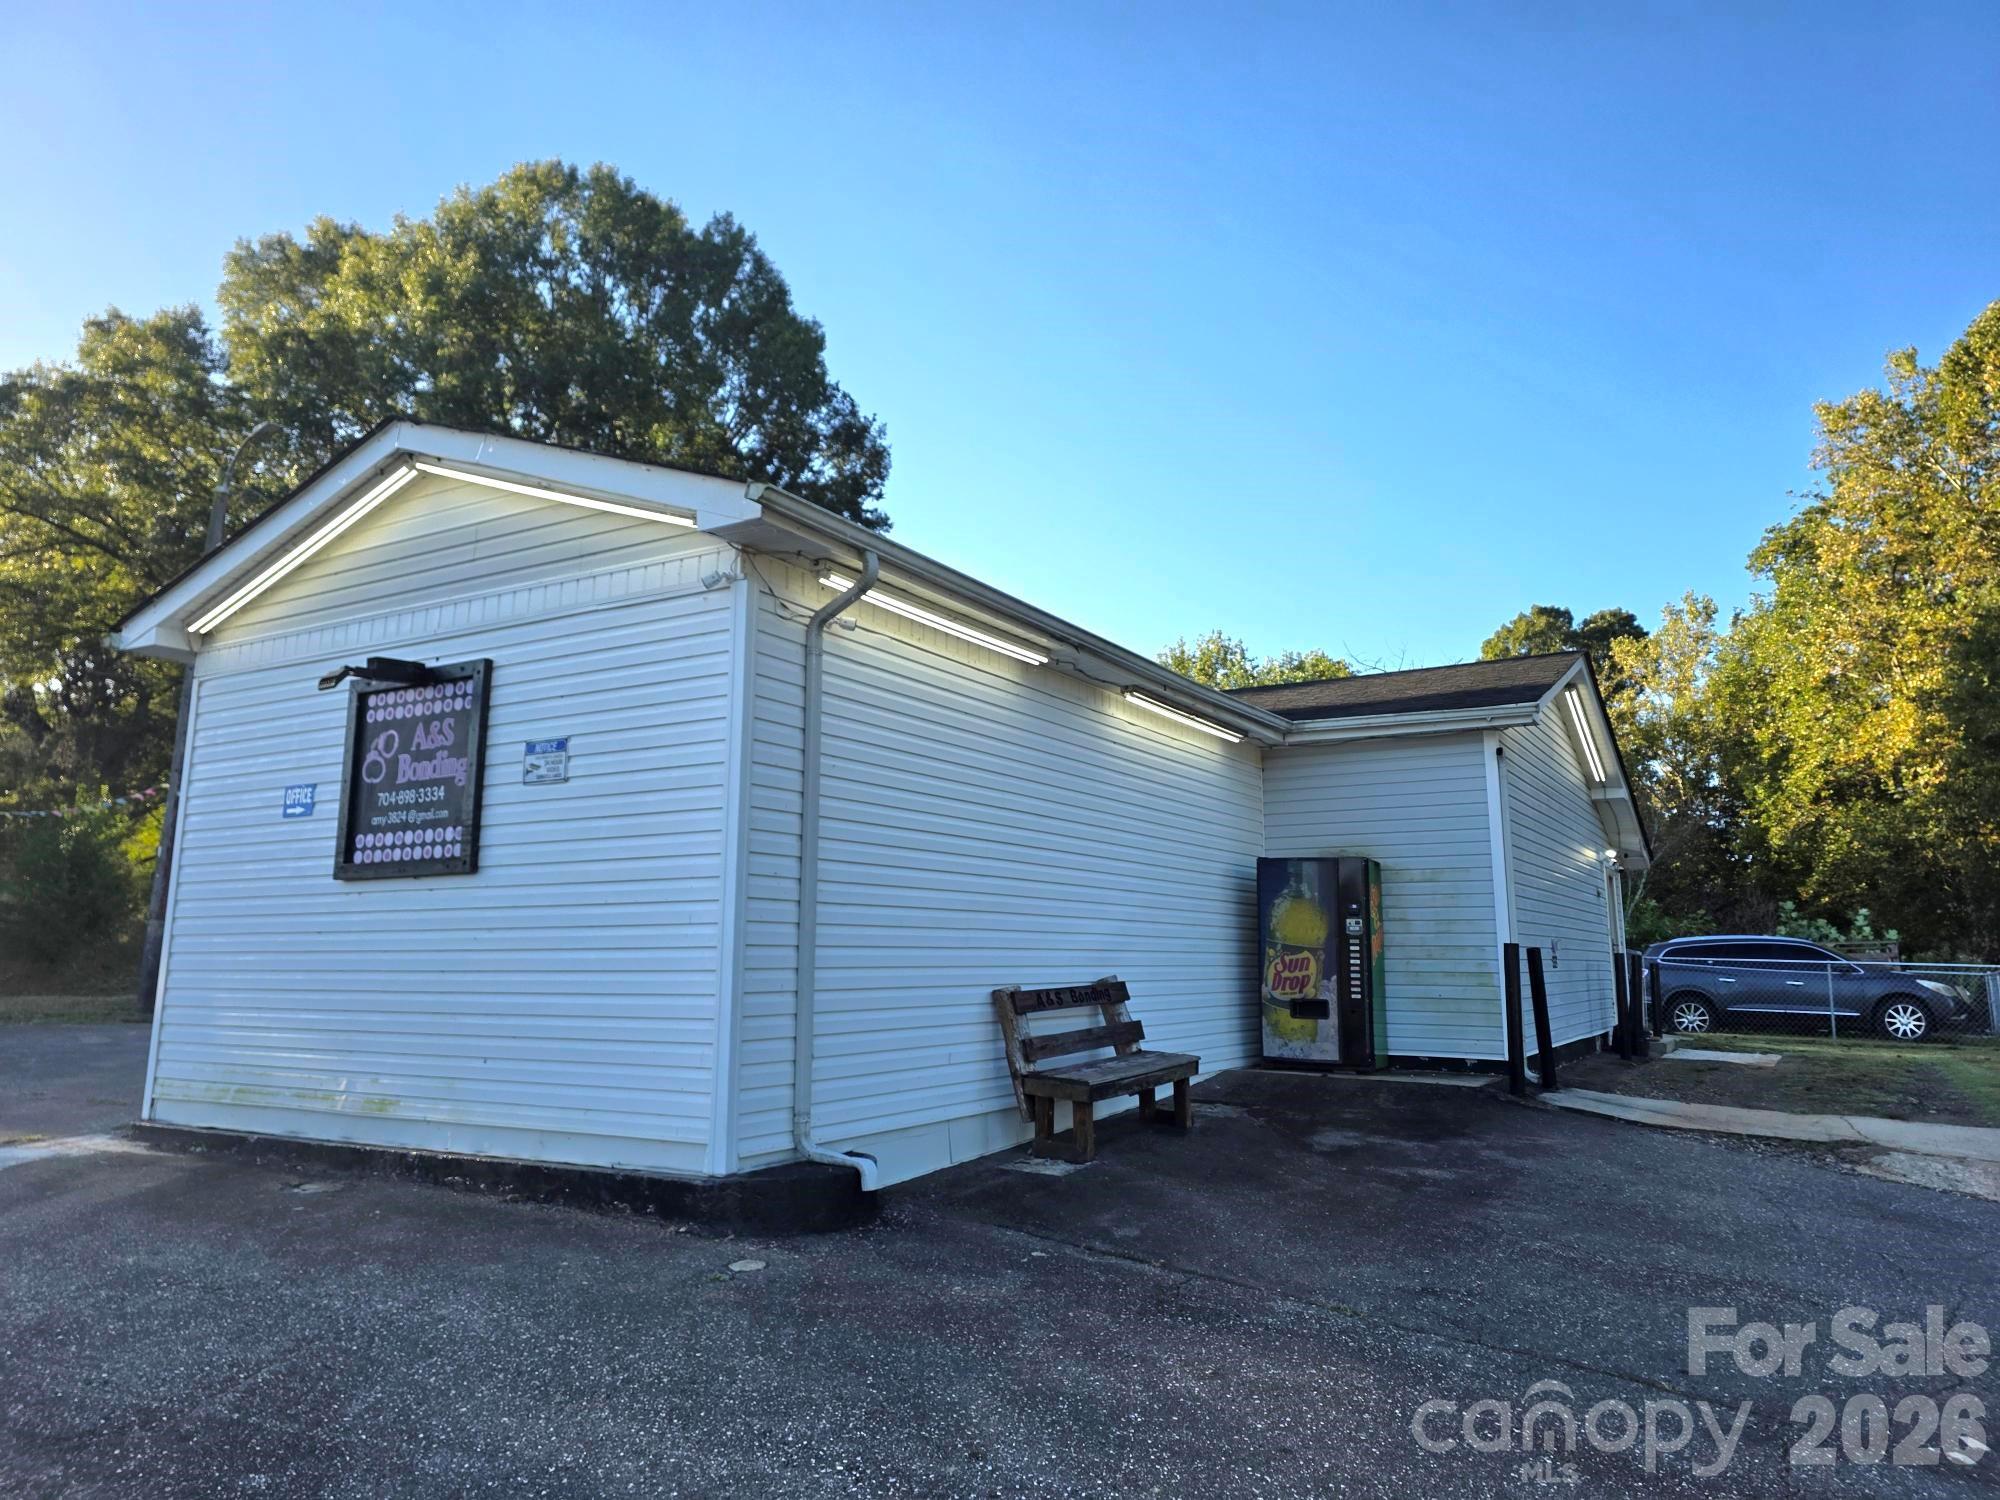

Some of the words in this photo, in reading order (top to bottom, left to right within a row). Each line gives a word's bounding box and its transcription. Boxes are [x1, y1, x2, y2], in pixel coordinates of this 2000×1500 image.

[410, 717, 455, 751] A&S
[396, 750, 468, 786] Bonding
[286, 787, 313, 804] OFFICE
[377, 785, 445, 807] 704-898-3334
[1274, 952, 1311, 973] Sun
[1271, 972, 1312, 994] Drop
[1036, 991, 1064, 1008] A&S
[1070, 987, 1112, 1003] Bonding
